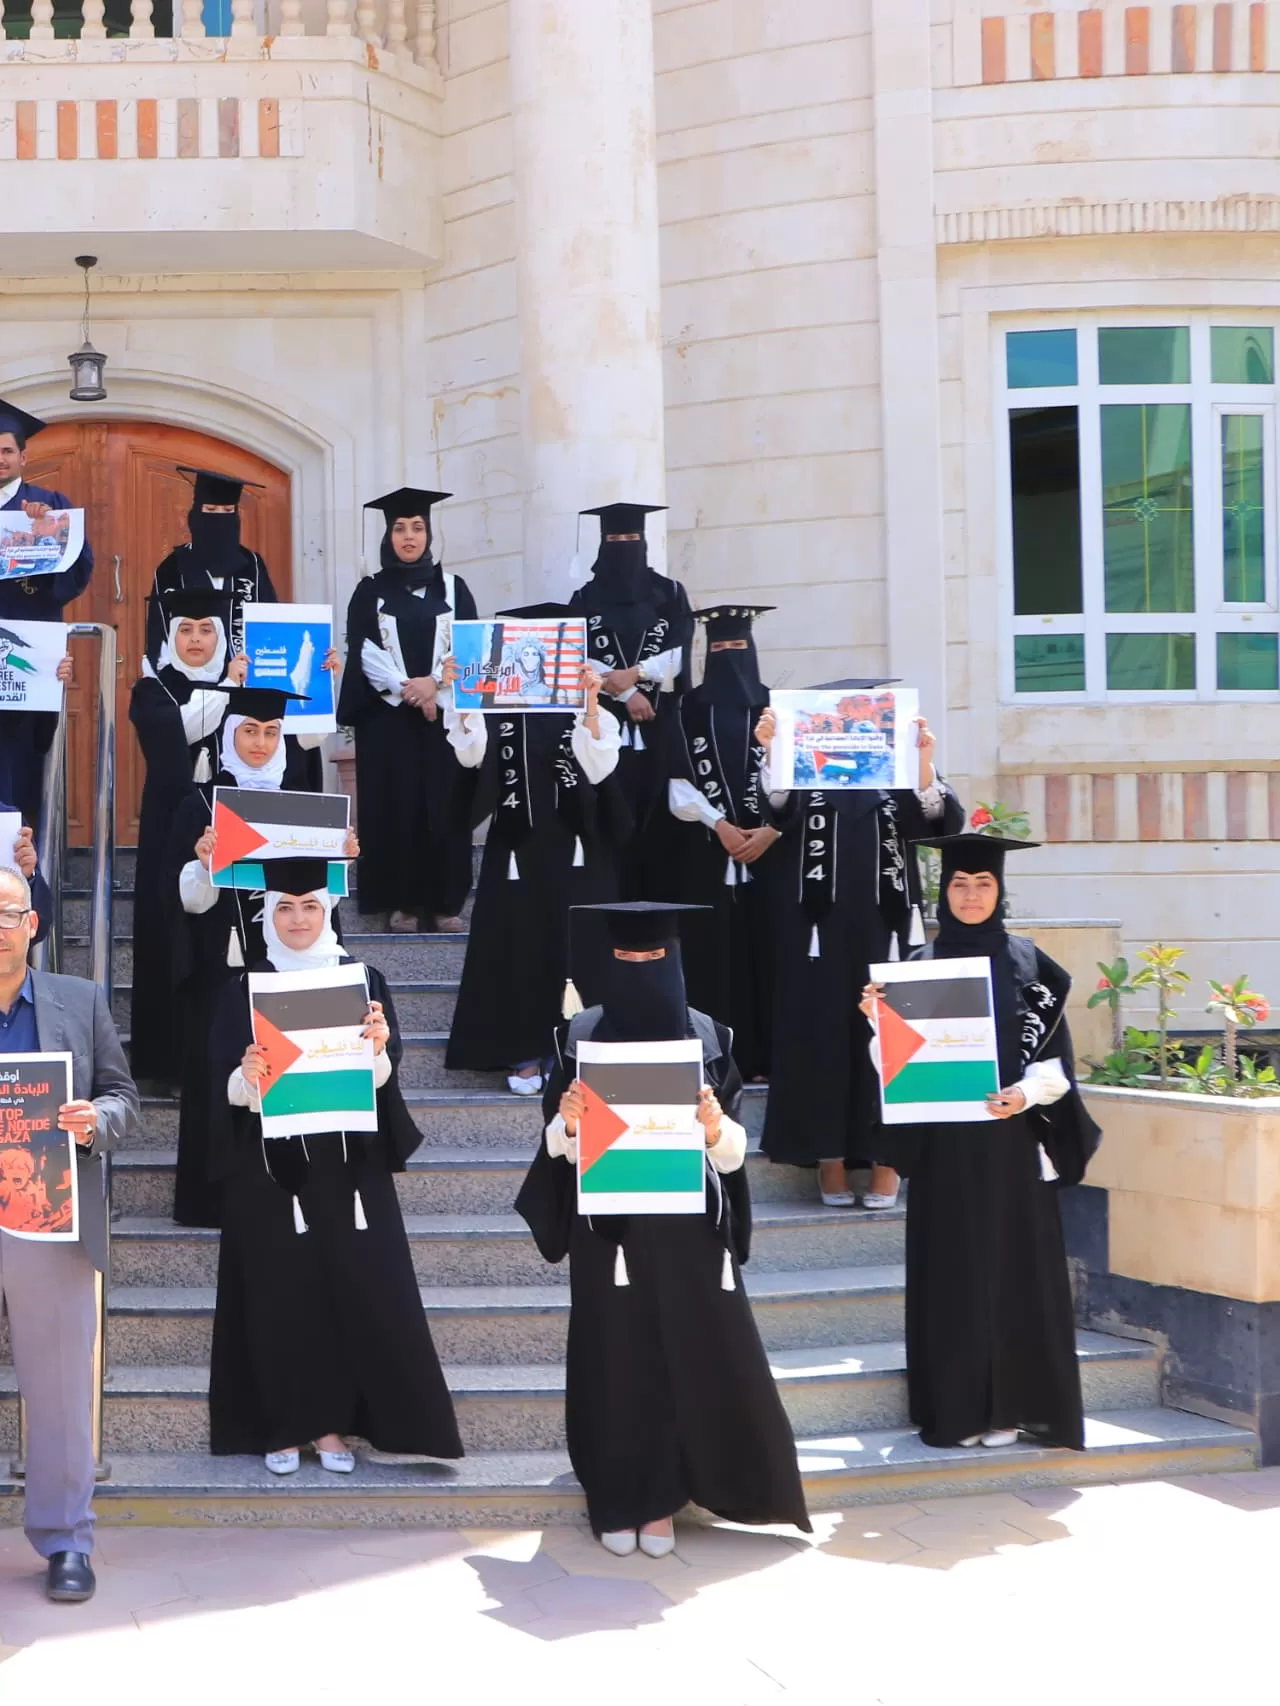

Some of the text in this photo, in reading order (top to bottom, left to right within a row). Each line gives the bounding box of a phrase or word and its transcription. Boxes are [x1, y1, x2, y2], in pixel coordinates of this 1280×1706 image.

[589, 616, 617, 668] 202
[500, 722, 520, 808] 2024
[806, 791, 826, 880] 2024
[13, 1082, 49, 1096] الإبادة
[13, 1096, 24, 1106] في
